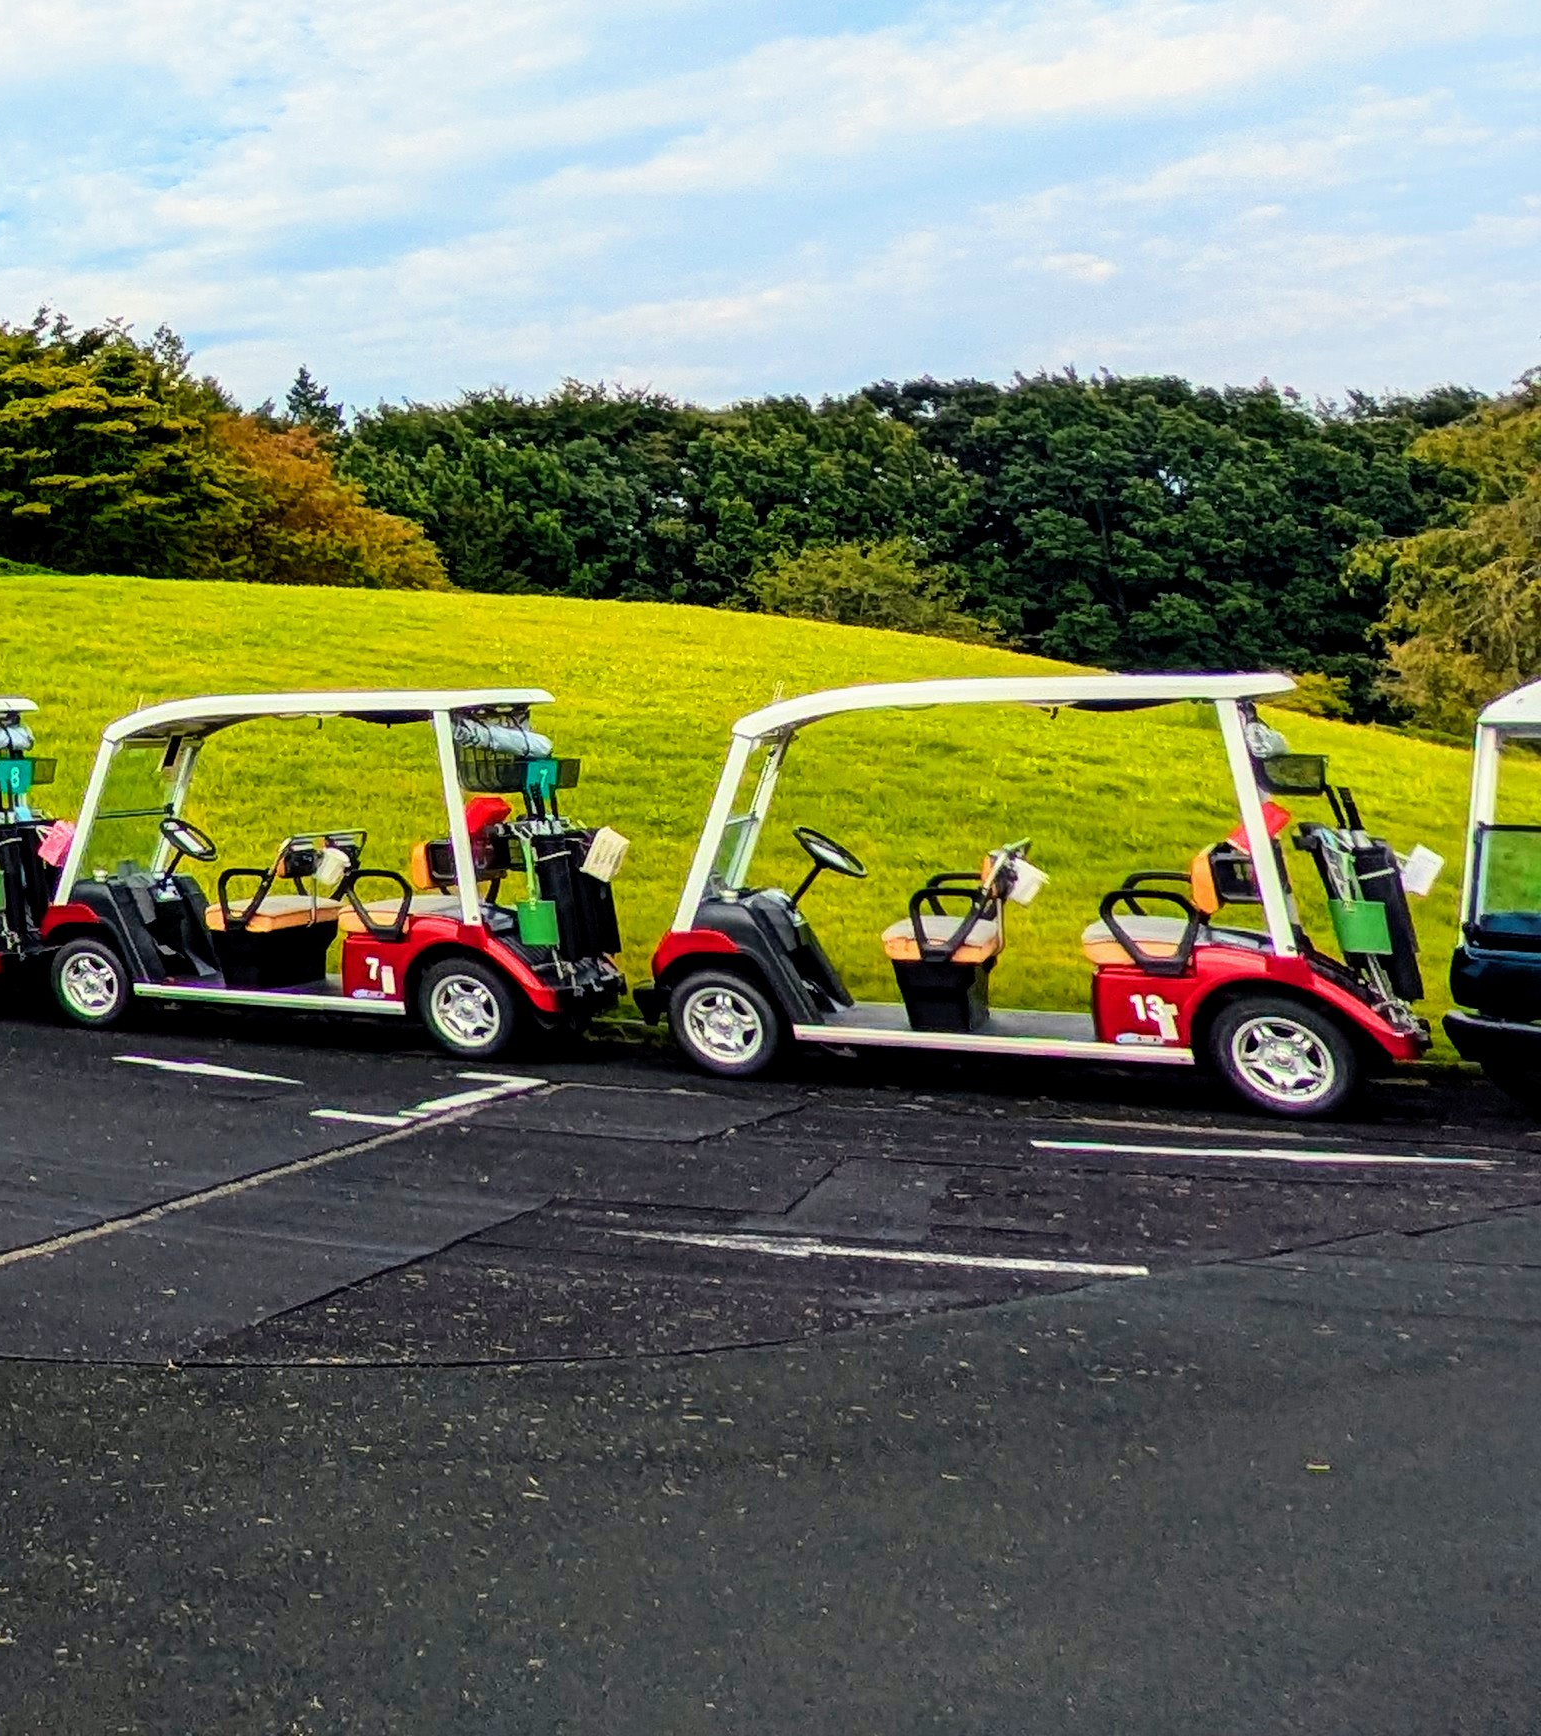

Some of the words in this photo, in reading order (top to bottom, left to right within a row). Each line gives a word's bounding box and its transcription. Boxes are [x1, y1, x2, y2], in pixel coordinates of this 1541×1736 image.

[10, 766, 20, 789] 8
[539, 768, 548, 788] 7
[365, 956, 379, 981] 7
[1129, 993, 1165, 1022] 13
